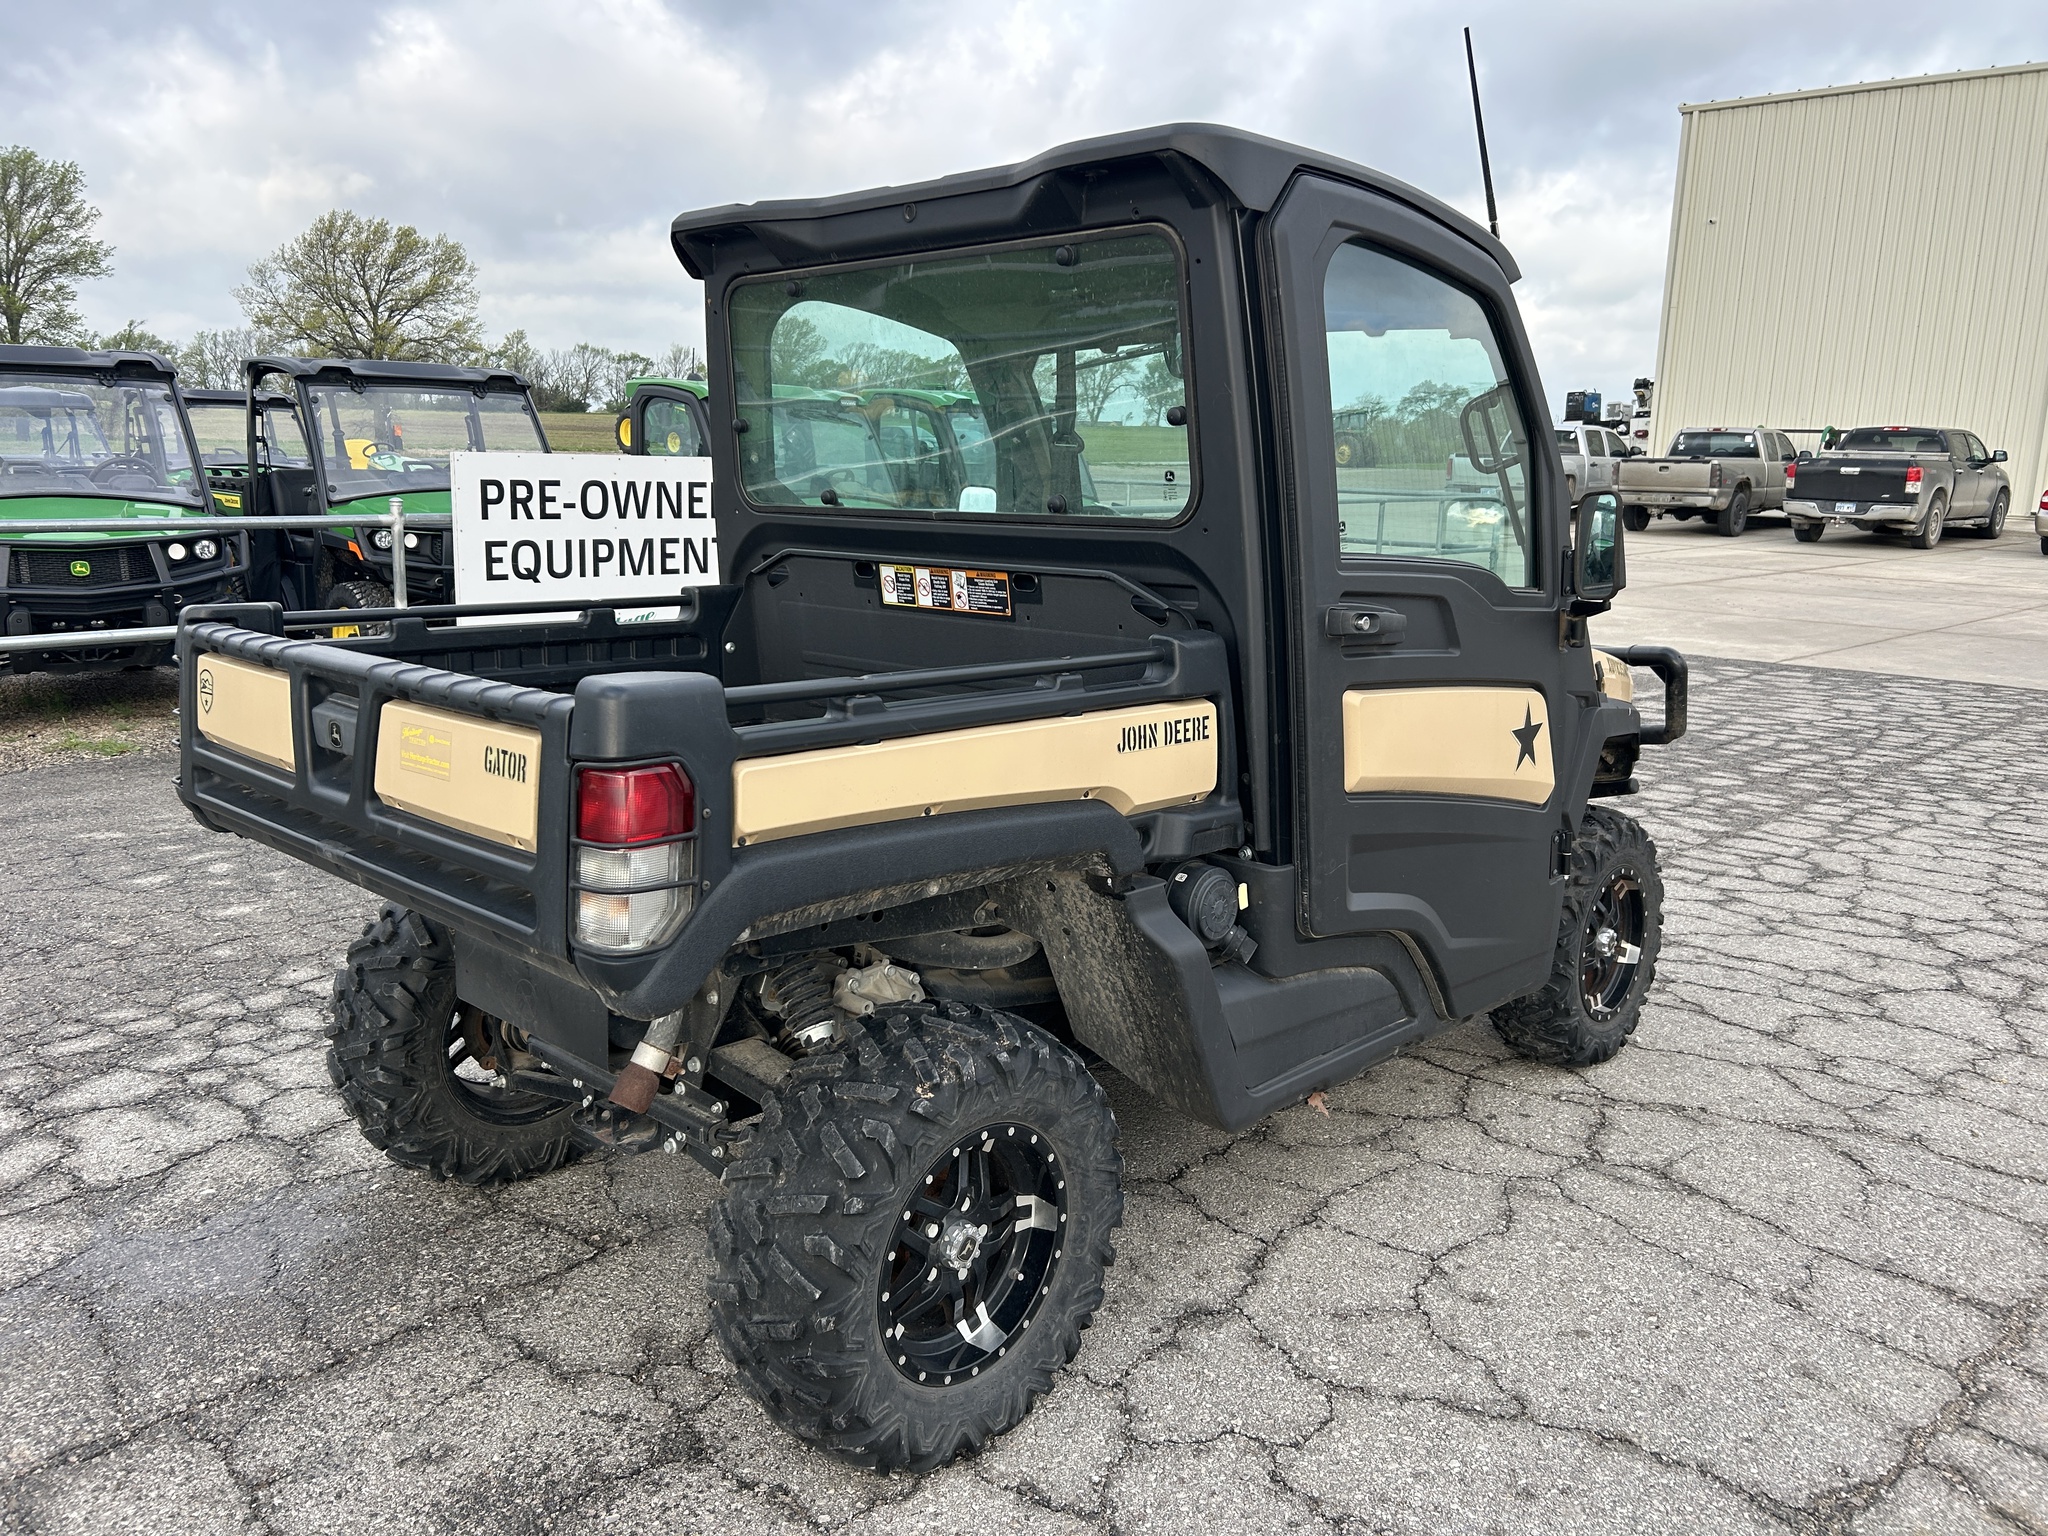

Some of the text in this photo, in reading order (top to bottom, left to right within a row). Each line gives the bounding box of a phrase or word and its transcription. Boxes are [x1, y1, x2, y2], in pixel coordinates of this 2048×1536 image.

[480, 478, 716, 520] PRE-OWNE
[1117, 715, 1210, 753] JOHN DEERE
[484, 745, 527, 783] GATOR
